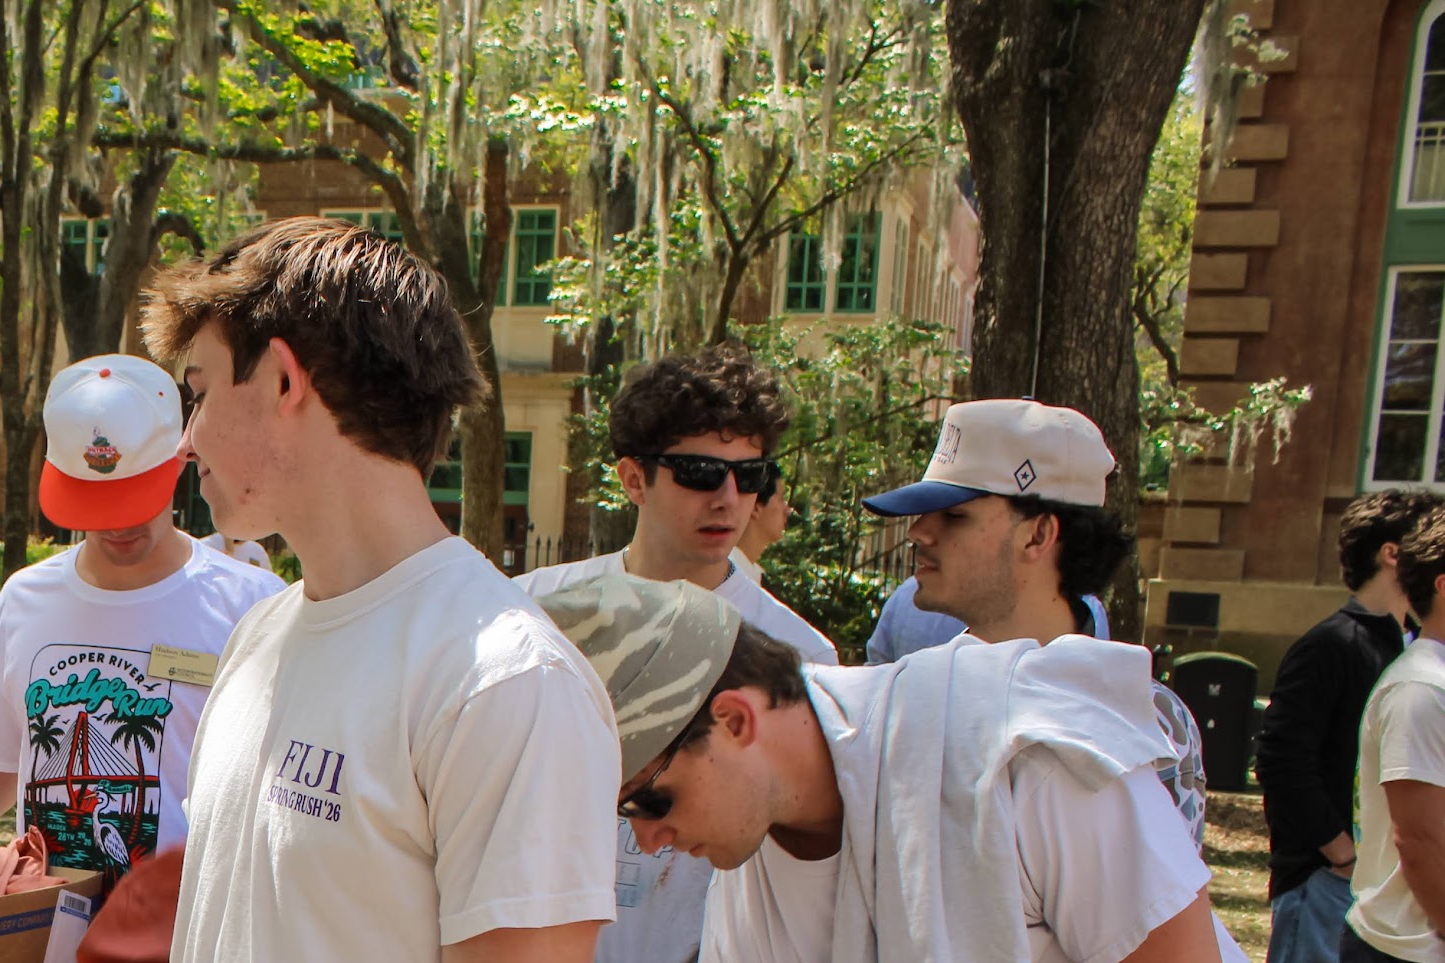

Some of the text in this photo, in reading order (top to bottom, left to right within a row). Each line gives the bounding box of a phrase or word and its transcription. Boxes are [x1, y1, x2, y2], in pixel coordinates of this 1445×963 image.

[49, 652, 145, 685] COOPER RIVER
[25, 668, 173, 719] Bridge Run
[276, 740, 345, 796] FIJI
[267, 785, 297, 810] SPRING
[294, 793, 323, 818] RUSH
[47, 823, 66, 831] MARCH
